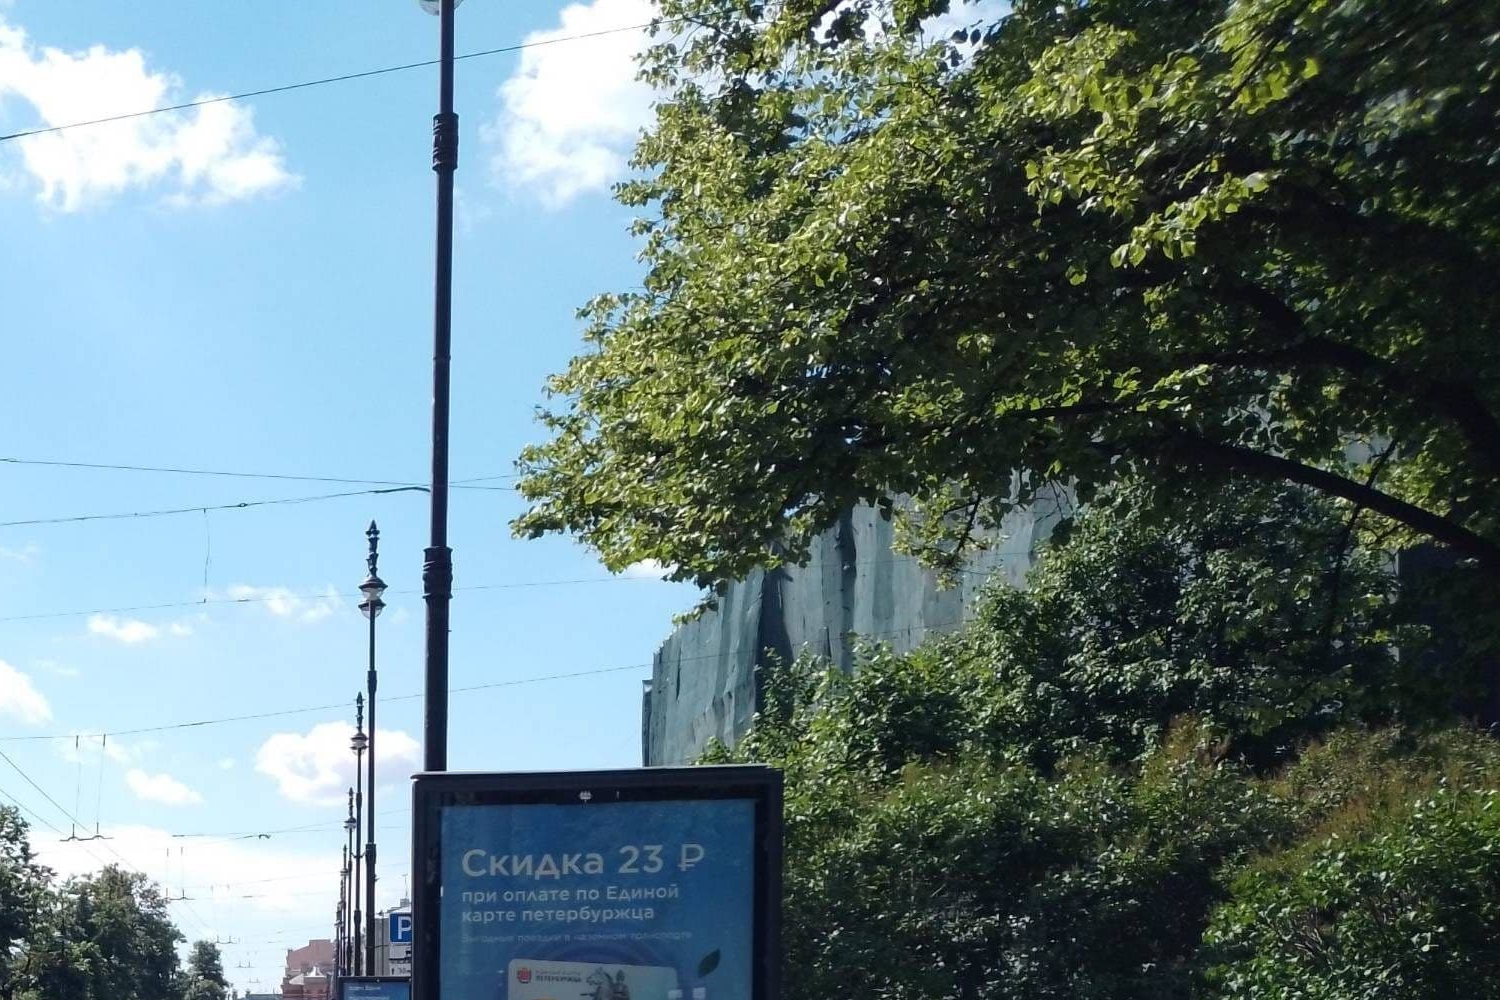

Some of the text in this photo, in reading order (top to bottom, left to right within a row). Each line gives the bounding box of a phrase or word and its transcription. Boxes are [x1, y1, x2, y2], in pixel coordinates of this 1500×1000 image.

[462, 849, 604, 880] Скидка
[618, 845, 663, 873] 23
[462, 884, 679, 904] при оплате по Единой
[462, 906, 655, 924] карте петербуржца
